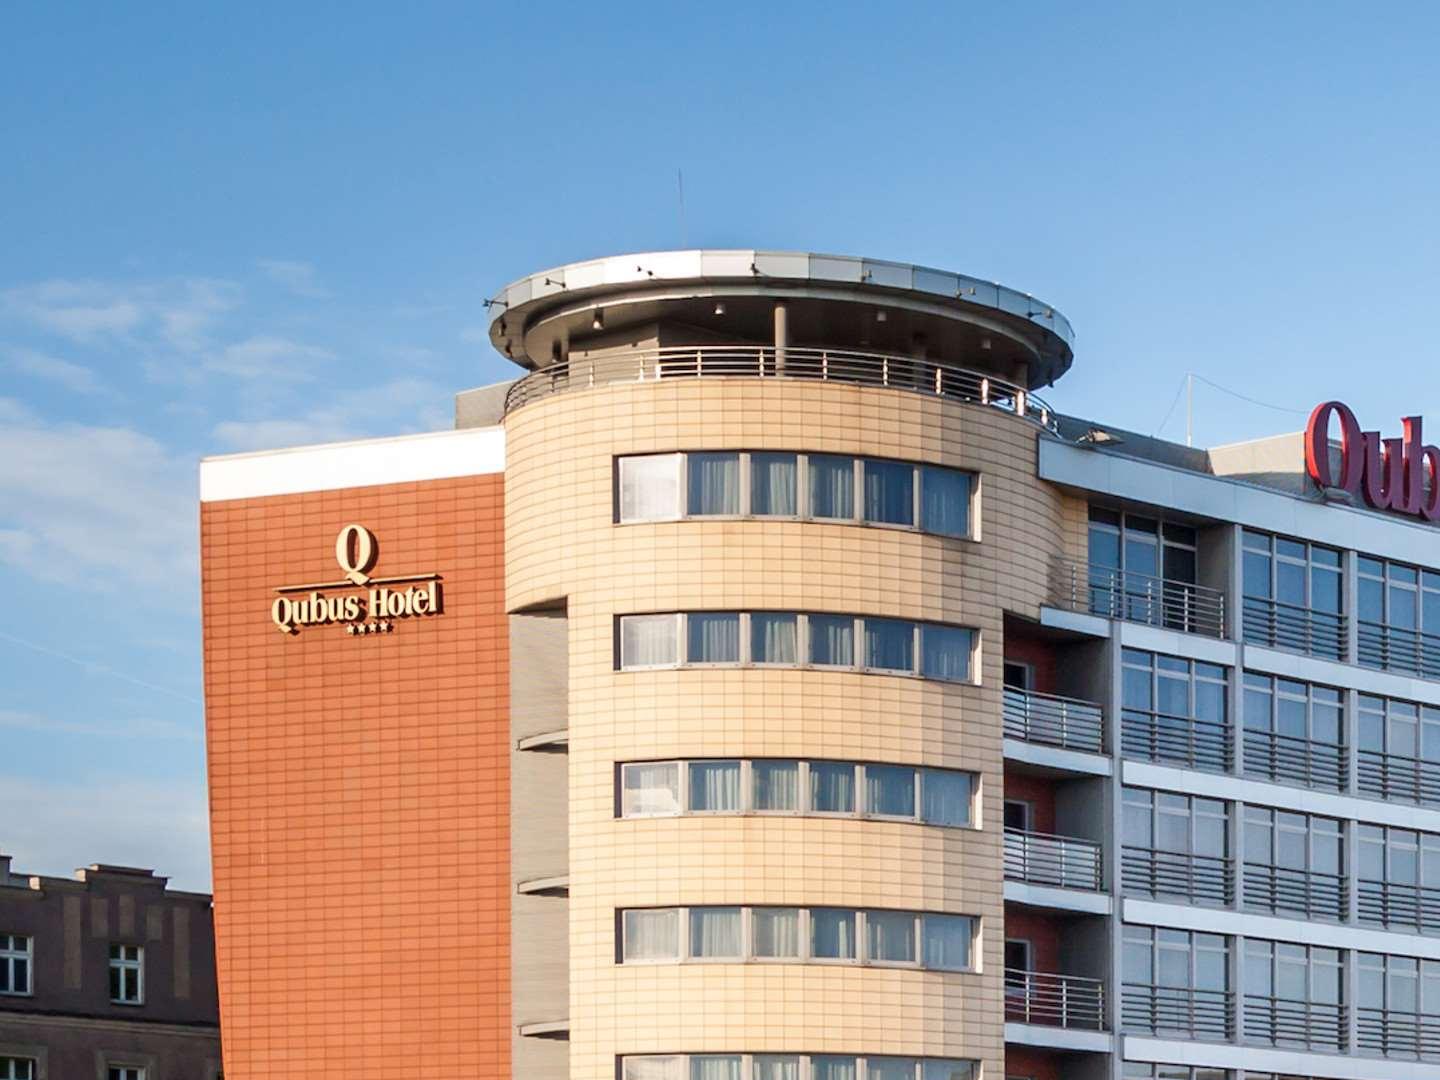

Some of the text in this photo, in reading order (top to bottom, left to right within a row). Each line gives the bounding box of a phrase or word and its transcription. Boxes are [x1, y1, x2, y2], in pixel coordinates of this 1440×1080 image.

[336, 524, 372, 585] Q
[271, 581, 438, 633] Qubus Hotel
